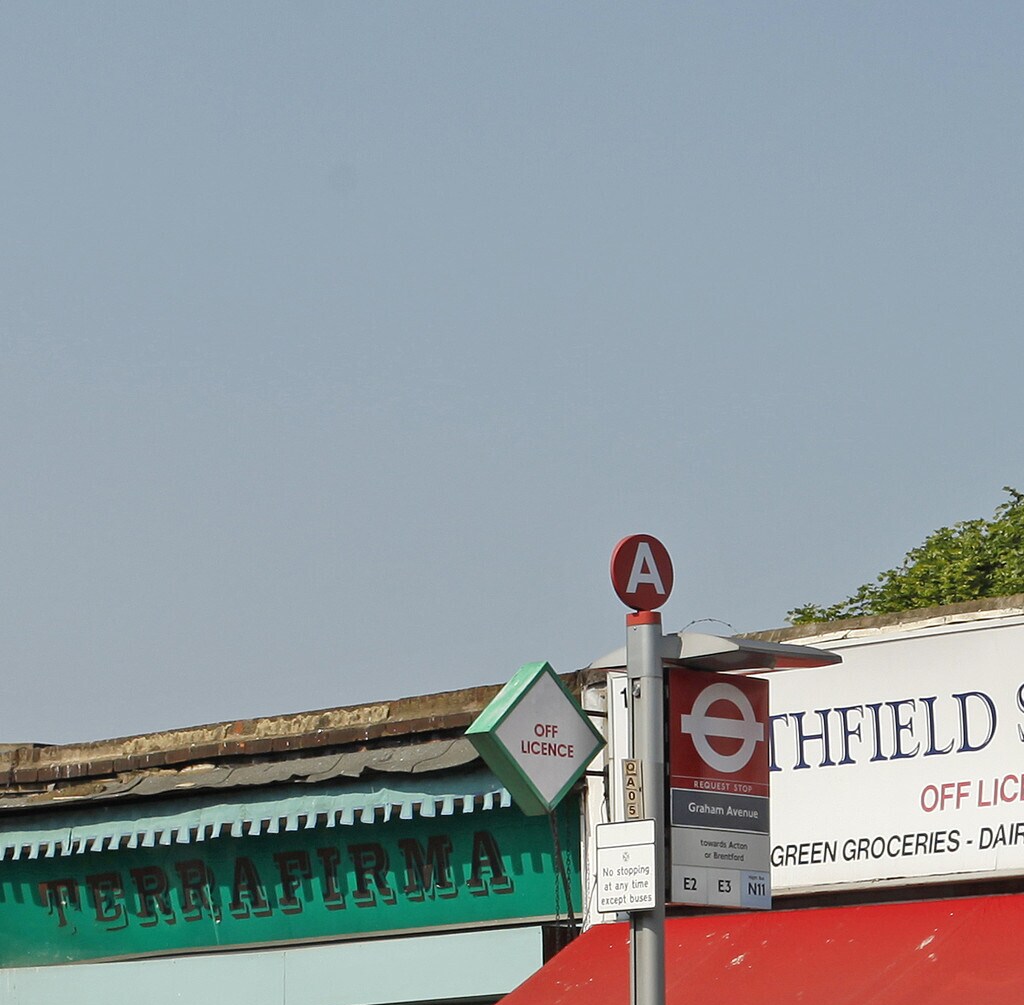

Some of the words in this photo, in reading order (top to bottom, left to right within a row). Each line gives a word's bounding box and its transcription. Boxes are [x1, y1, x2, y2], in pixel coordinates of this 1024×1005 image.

[626, 541, 666, 595] A
[534, 723, 558, 738] OFF
[521, 740, 574, 758] LICENCE
[693, 780, 730, 790] REQUEST
[733, 783, 753, 792] STOP
[920, 780, 972, 812] OFF
[688, 802, 725, 816] Graham
[726, 806, 759, 819] Avenue
[700, 839, 727, 848] towards
[728, 841, 748, 850] Acton
[770, 840, 837, 868] GREEN
[842, 829, 960, 862] GROCERIES
[713, 851, 745, 862] Brentford
[602, 867, 614, 877] No
[616, 865, 650, 876] stopping
[603, 881, 612, 891] at
[614, 882, 629, 891] any
[631, 879, 649, 889] time
[683, 877, 697, 891] E2
[718, 879, 732, 893] E3
[748, 882, 766, 896] N11
[601, 894, 627, 905] except
[629, 893, 652, 904] buses
